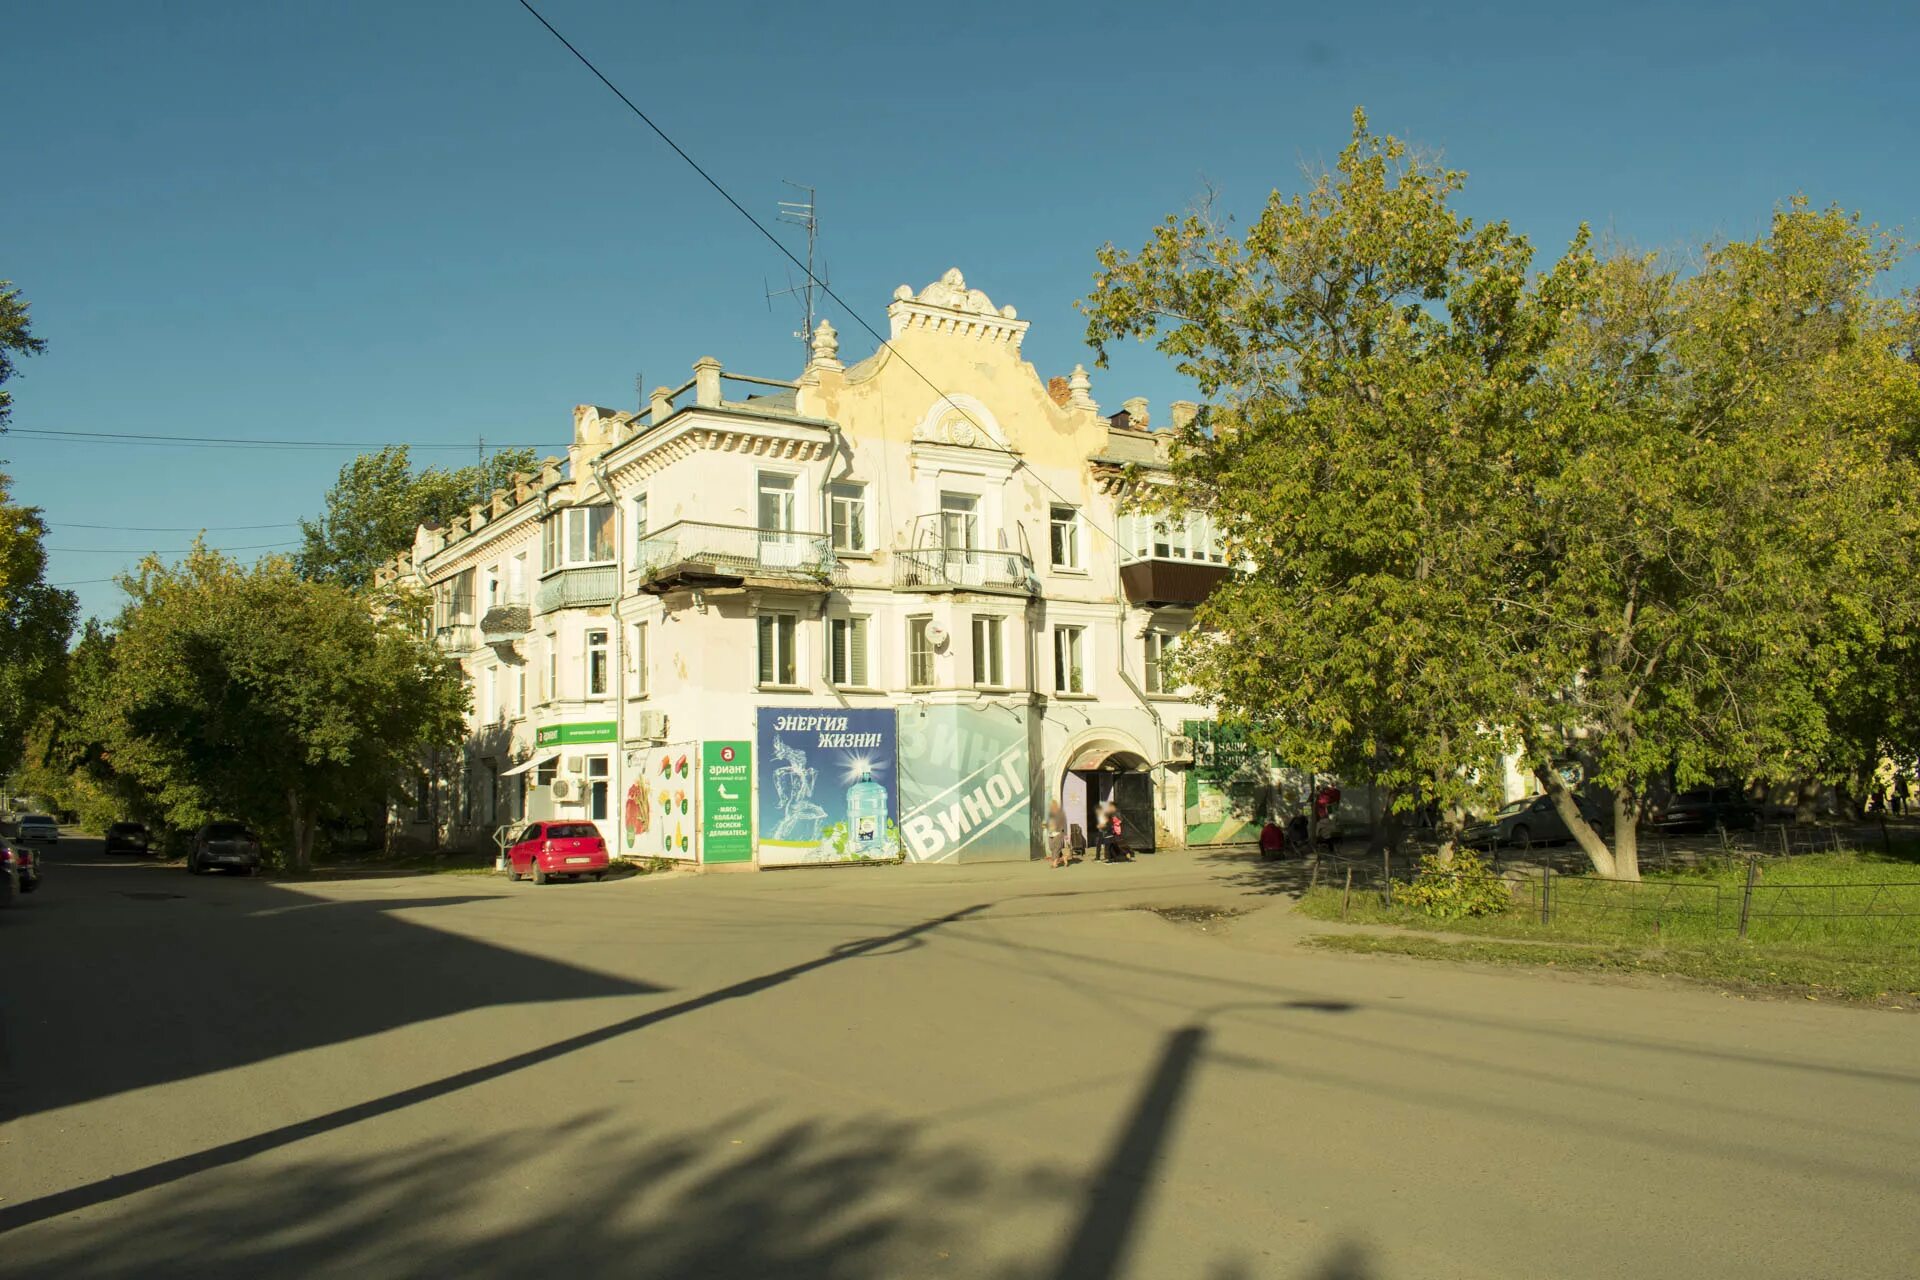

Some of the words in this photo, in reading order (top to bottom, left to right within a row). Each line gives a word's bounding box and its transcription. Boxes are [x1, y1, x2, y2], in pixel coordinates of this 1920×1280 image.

[773, 716, 848, 731] ЭНЕРГИЯ
[818, 733, 882, 748] ЖИЗНИ!
[709, 765, 747, 776] ариант
